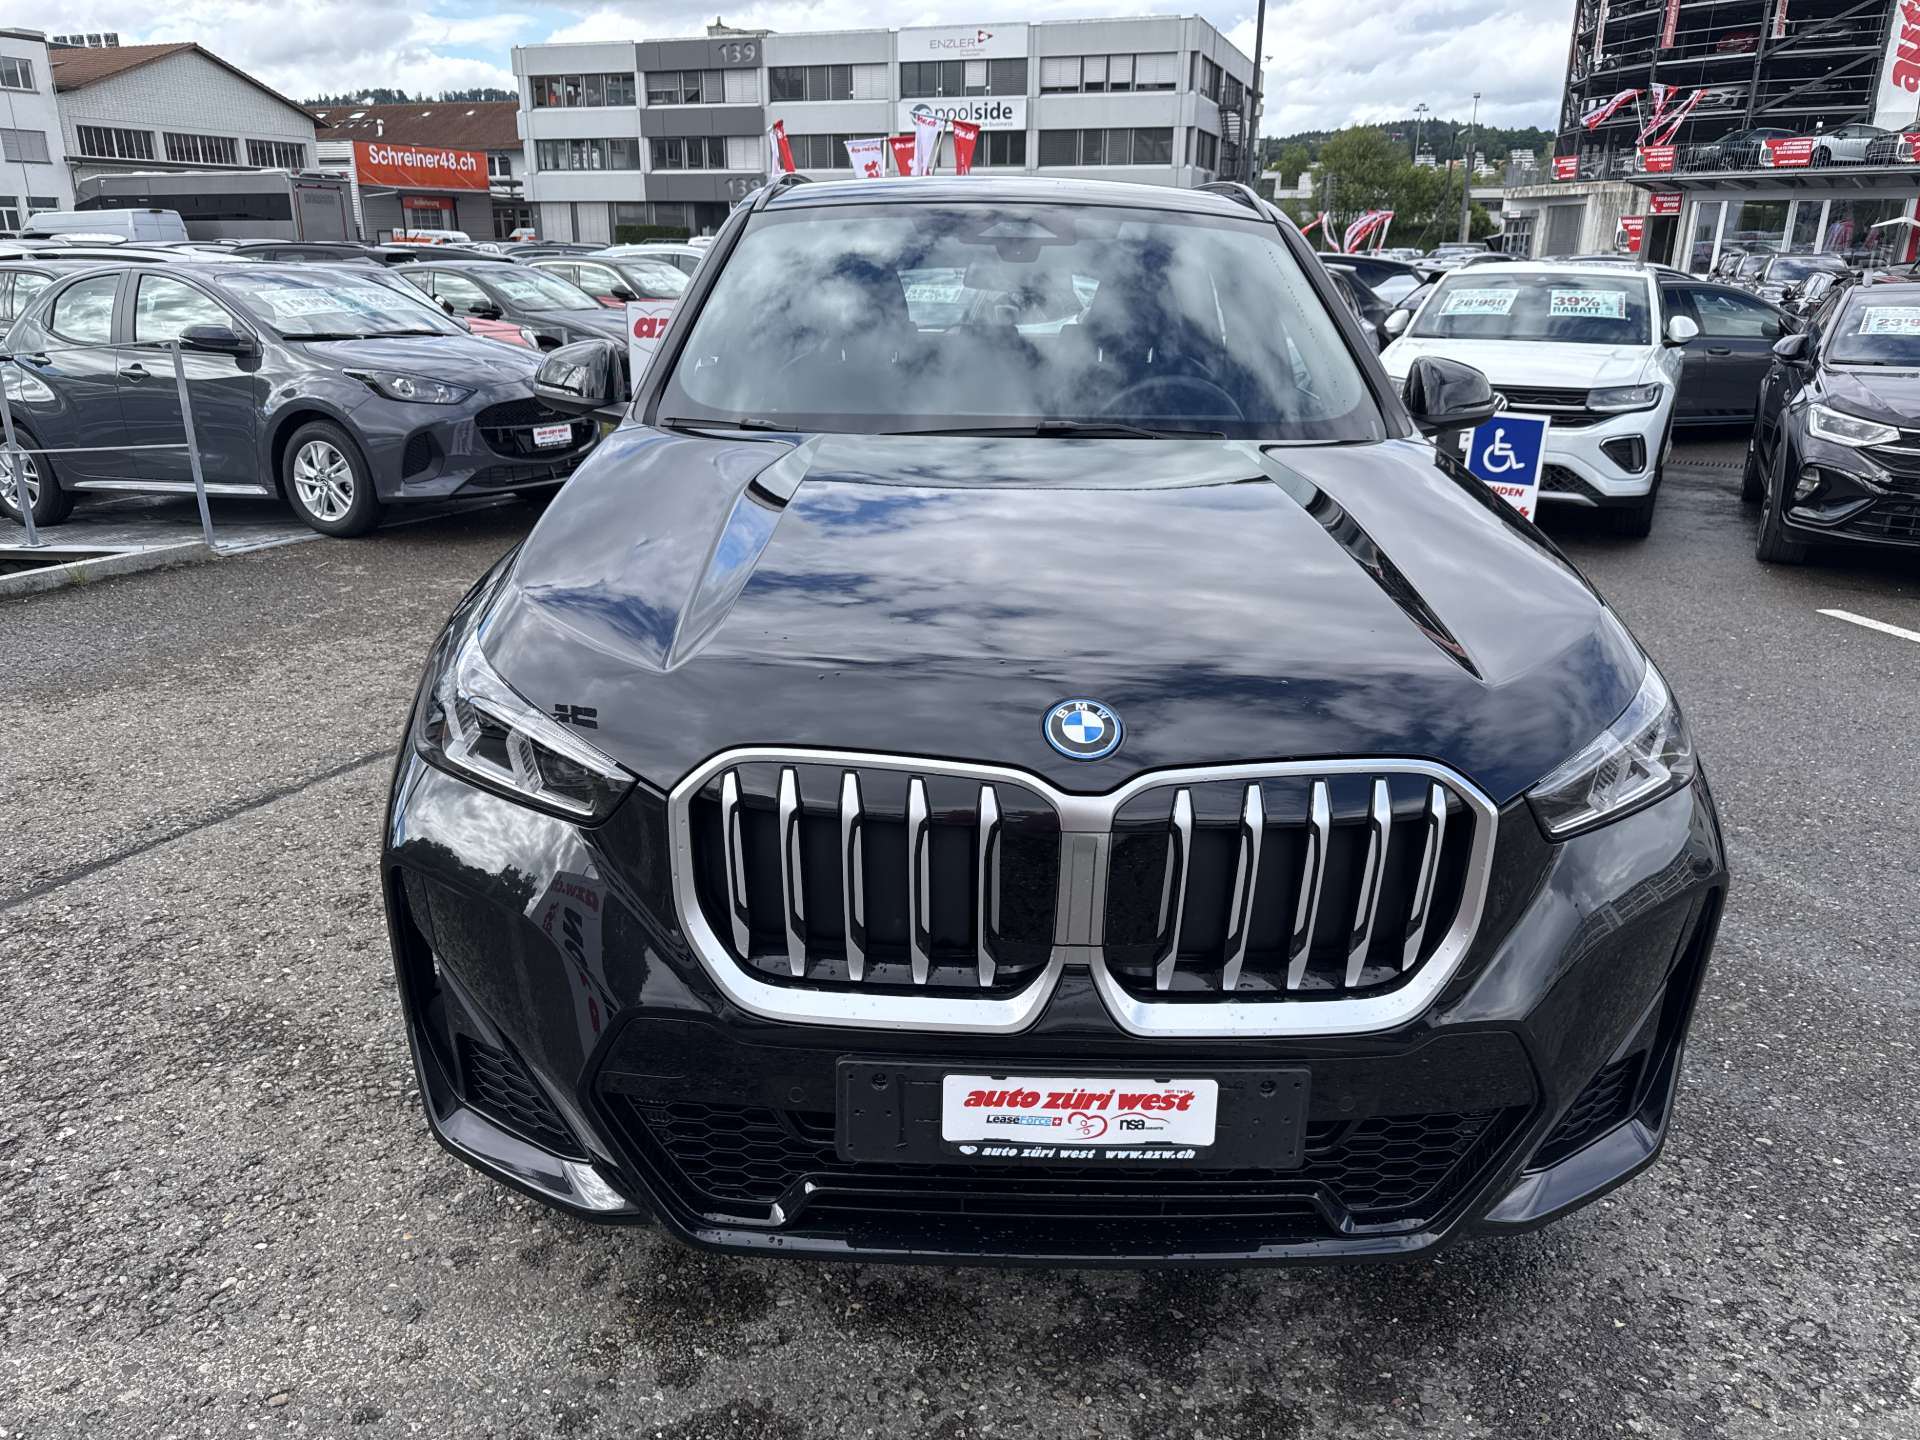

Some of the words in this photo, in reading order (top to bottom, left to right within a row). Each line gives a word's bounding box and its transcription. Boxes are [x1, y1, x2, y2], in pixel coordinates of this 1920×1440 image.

[929, 38, 976, 49] ENZLER
[719, 42, 756, 63] 139
[935, 101, 1013, 121] poolside
[368, 144, 477, 171] Schreiner48.ch
[1553, 296, 1601, 307] 39%
[1552, 306, 1601, 314] RABATT
[1489, 485, 1525, 497] NDEN
[1056, 703, 1109, 720] BMW
[964, 1087, 1041, 1108] auto
[1041, 1088, 1116, 1111] züri
[1118, 1092, 1195, 1111] west
[986, 1114, 1052, 1127] LeaseForce
[1119, 1119, 1146, 1131] nsa
[981, 1147, 1018, 1157] auto
[1020, 1147, 1057, 1158] züri
[1059, 1149, 1096, 1159] west
[1105, 1149, 1196, 1159] www.azw.ch
